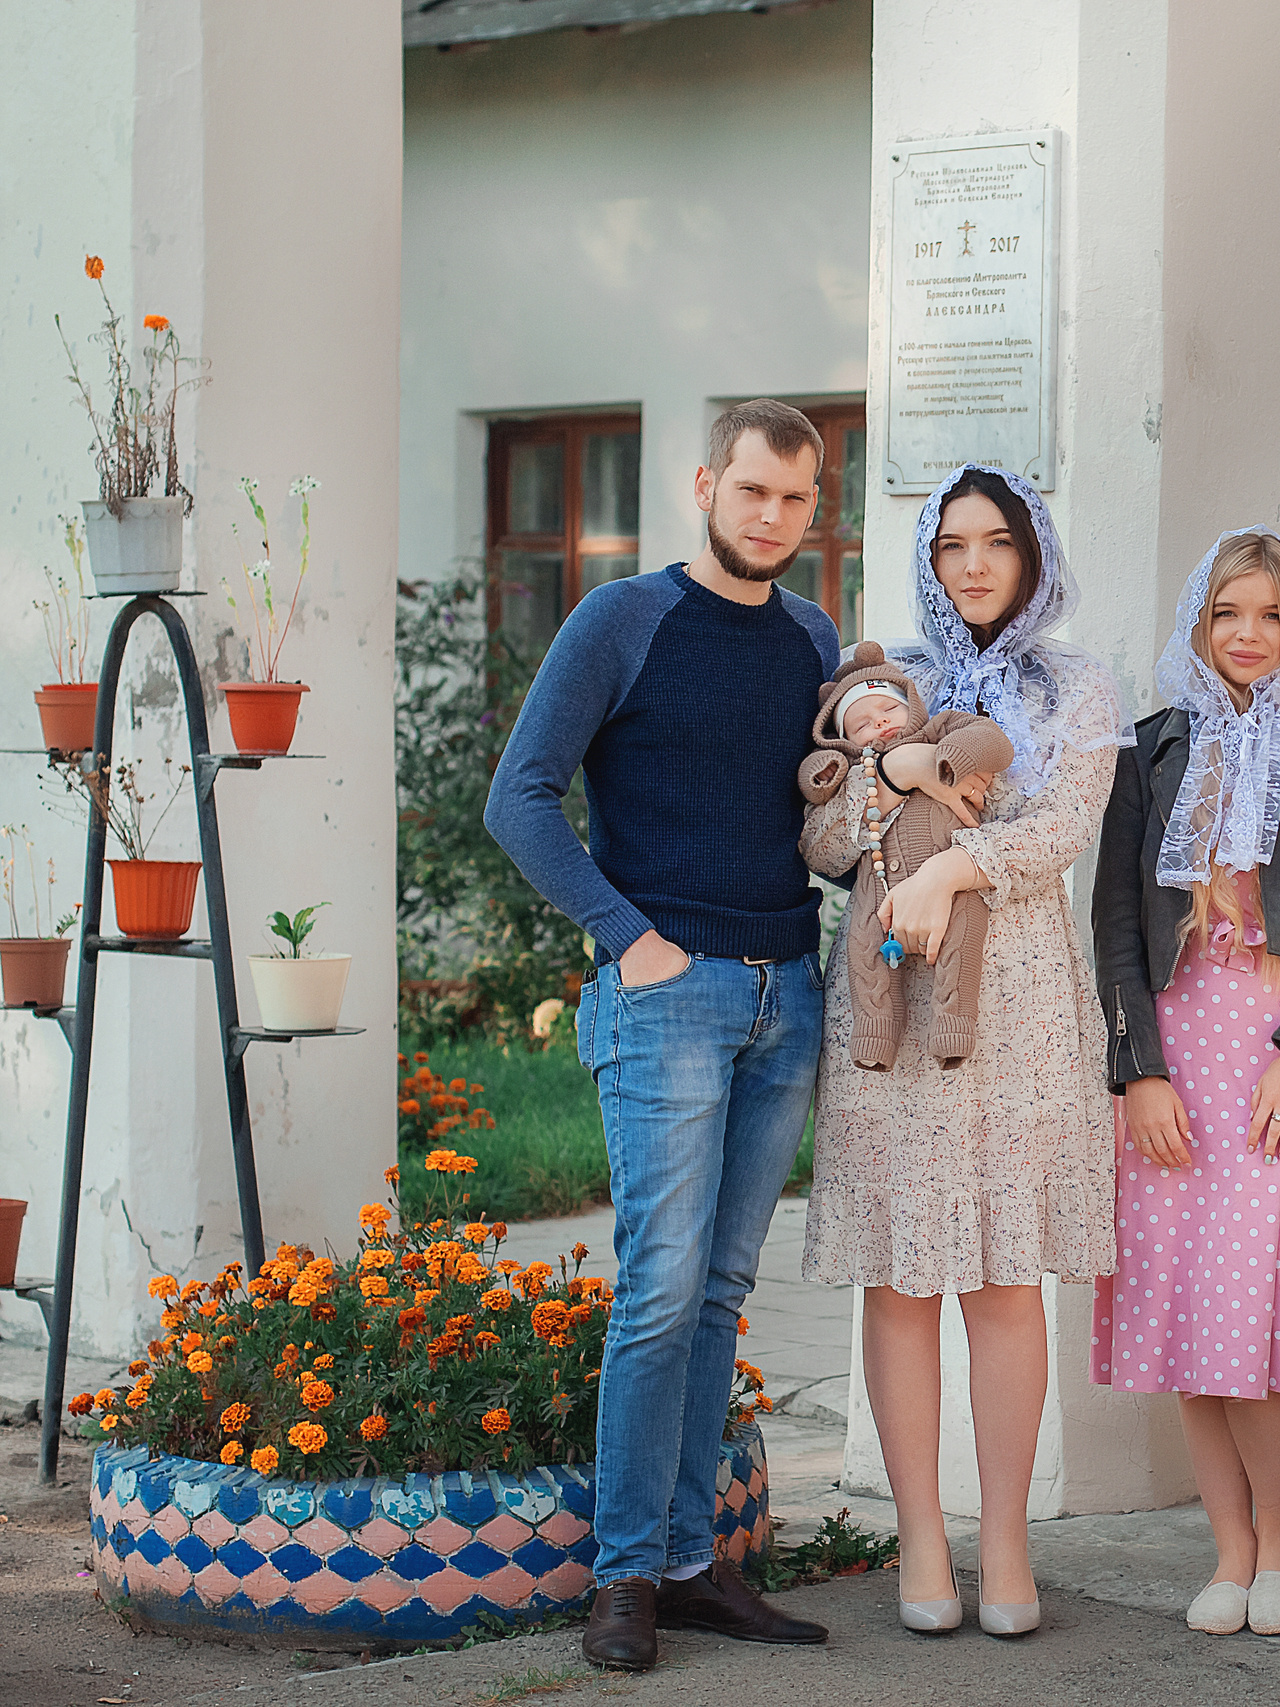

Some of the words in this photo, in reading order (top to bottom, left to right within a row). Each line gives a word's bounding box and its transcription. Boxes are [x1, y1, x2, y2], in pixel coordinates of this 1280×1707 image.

[997, 163, 1028, 172] Церковь
[964, 184, 1010, 193] Митрополия
[914, 241, 942, 258] 1917
[990, 236, 1020, 253] 2017
[972, 272, 1027, 284] Митрополита
[926, 290, 963, 300] Брянского
[972, 287, 1006, 296] Севского
[926, 303, 1005, 316] АЛЕКСАНДРА
[1004, 337, 1032, 347] Церковь
[979, 352, 1012, 361] памятная
[1014, 351, 1034, 359] плита
[923, 461, 953, 469] ВЕЧНАЯ
